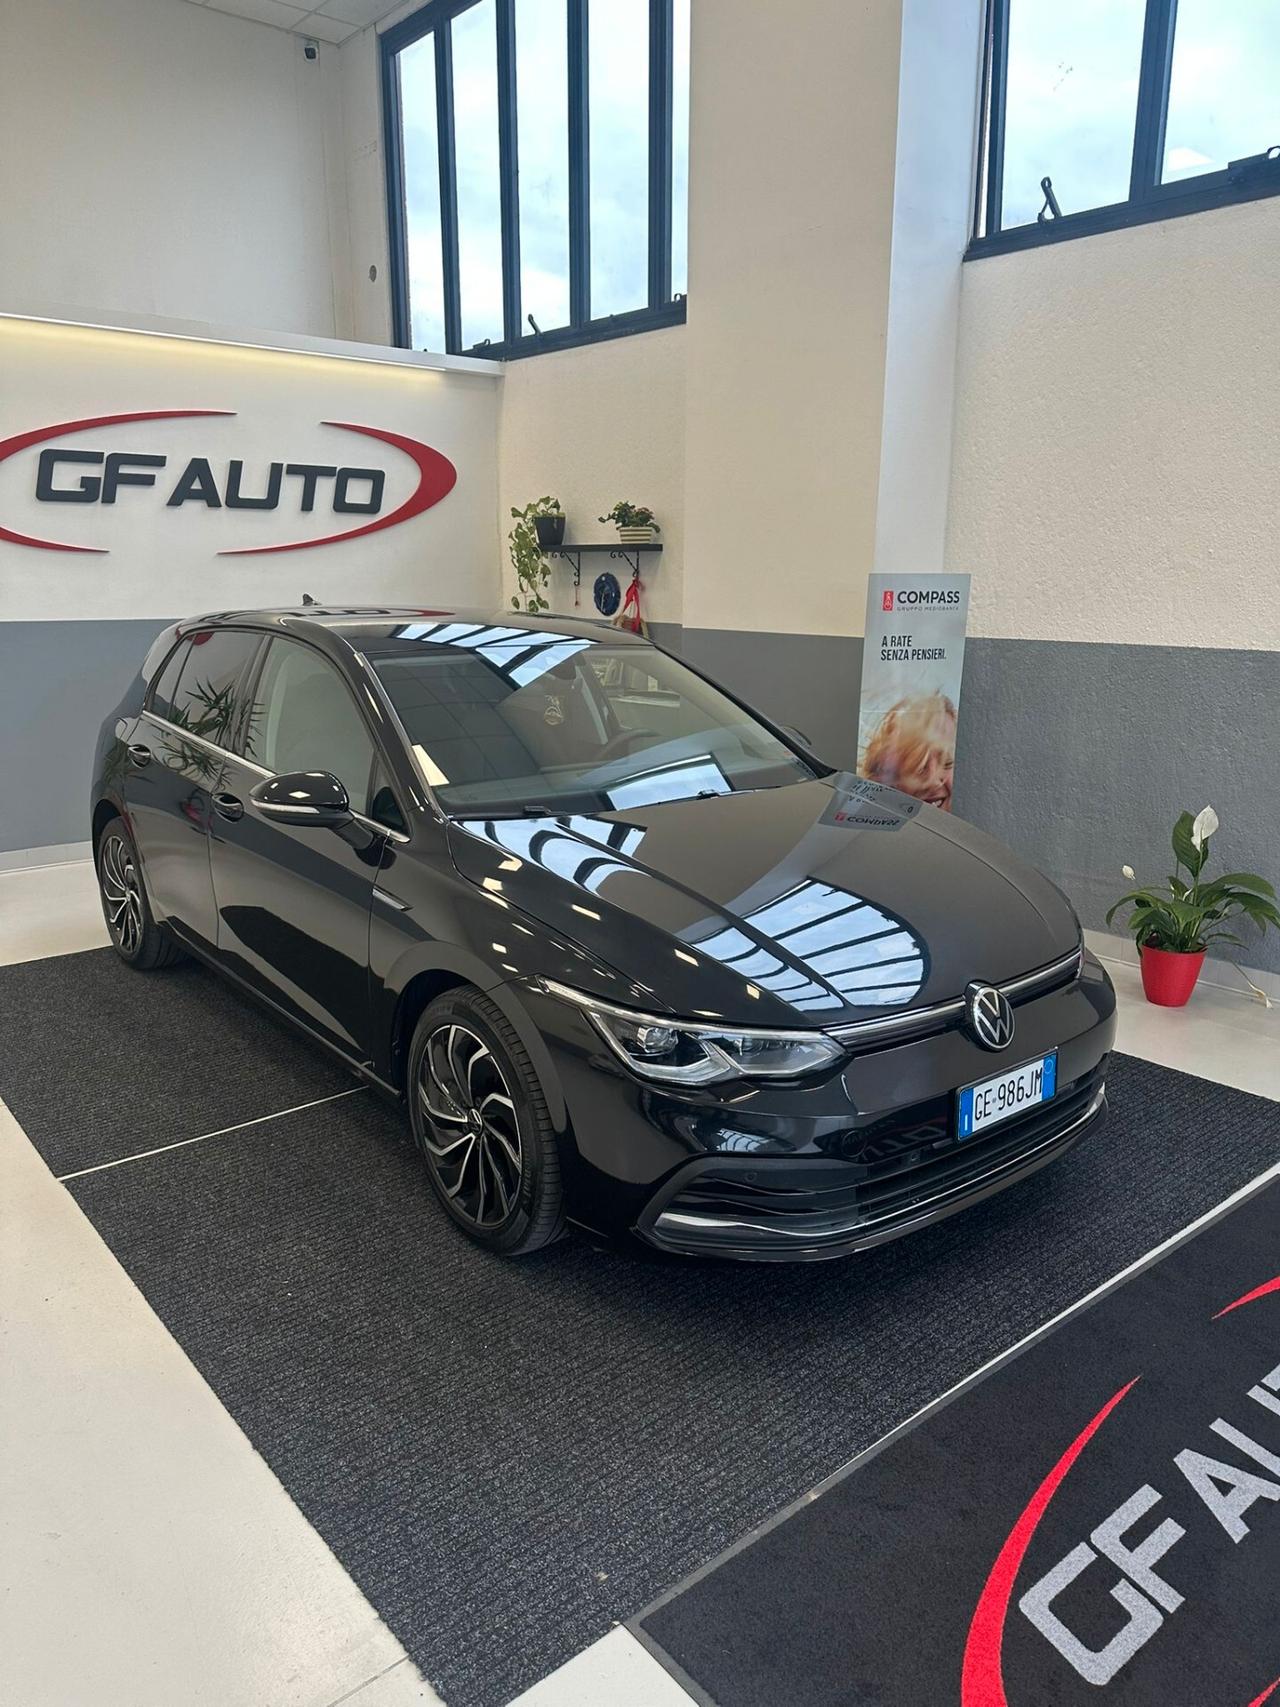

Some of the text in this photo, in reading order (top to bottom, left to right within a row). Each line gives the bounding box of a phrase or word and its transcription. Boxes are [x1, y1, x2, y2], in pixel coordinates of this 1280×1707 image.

[36, 449, 386, 514] GF AUTO
[897, 590, 960, 604] COMPASS
[881, 635, 913, 648] A RATE
[880, 648, 947, 661] SENZA PENSIERI.
